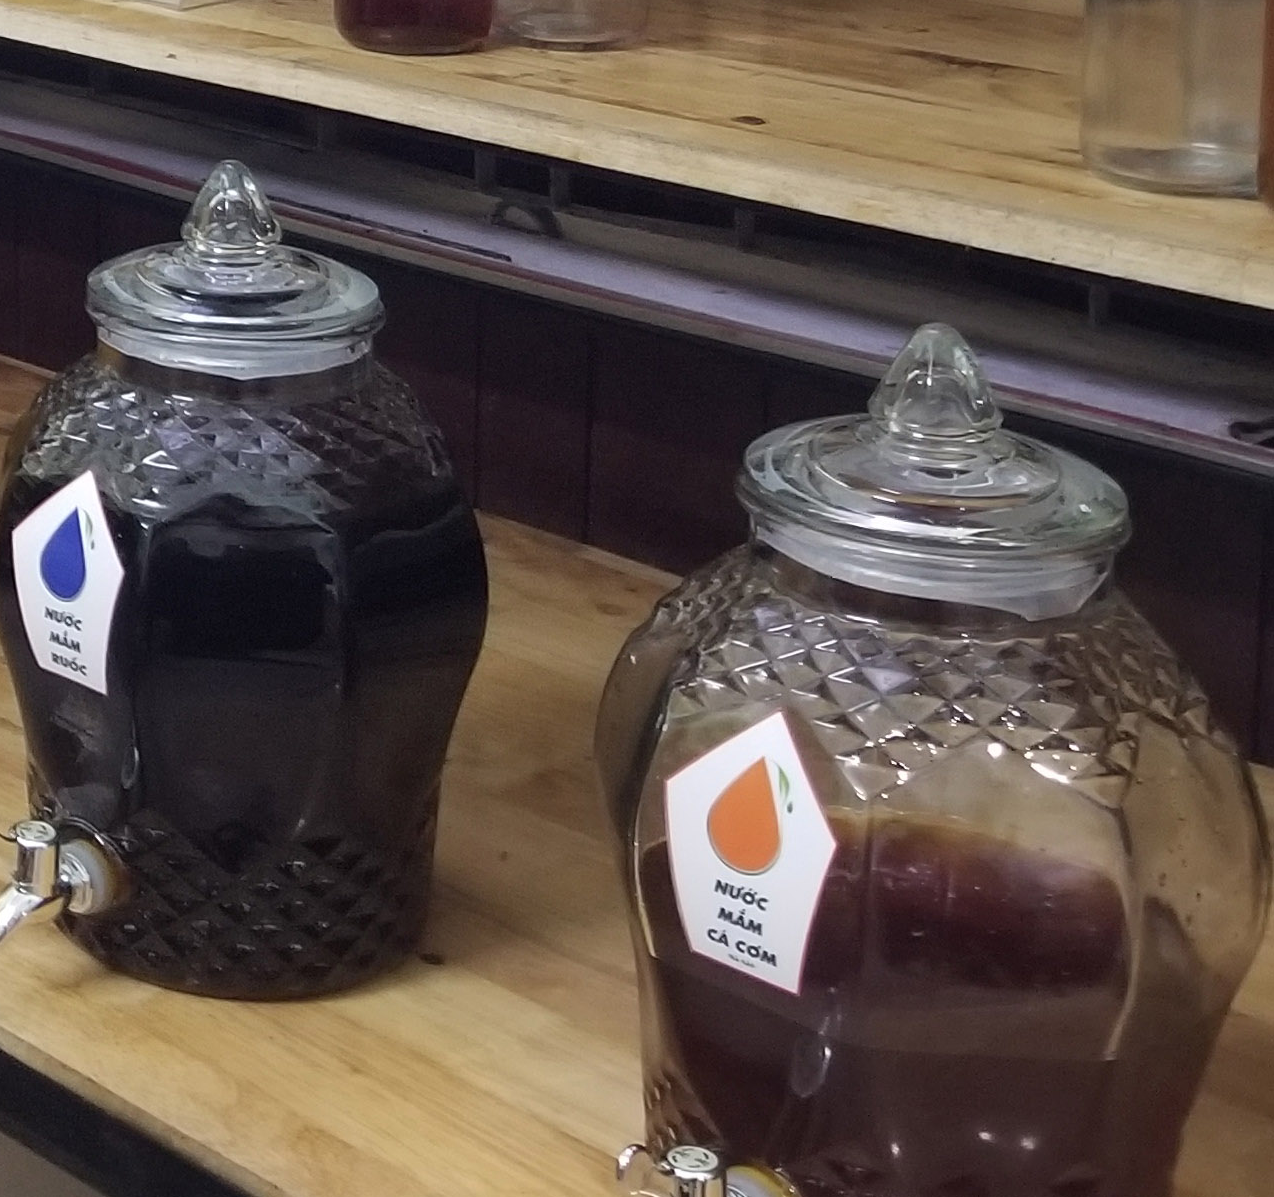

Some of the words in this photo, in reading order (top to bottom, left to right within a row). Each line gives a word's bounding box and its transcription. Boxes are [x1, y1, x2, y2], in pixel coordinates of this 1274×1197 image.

[49, 628, 81, 653] MẮM
[51, 651, 88, 677] RUỐC
[714, 879, 769, 911] NƯỚC
[717, 906, 763, 936] MẮM
[707, 928, 729, 948] CÁ
[735, 940, 778, 968] CƠM
